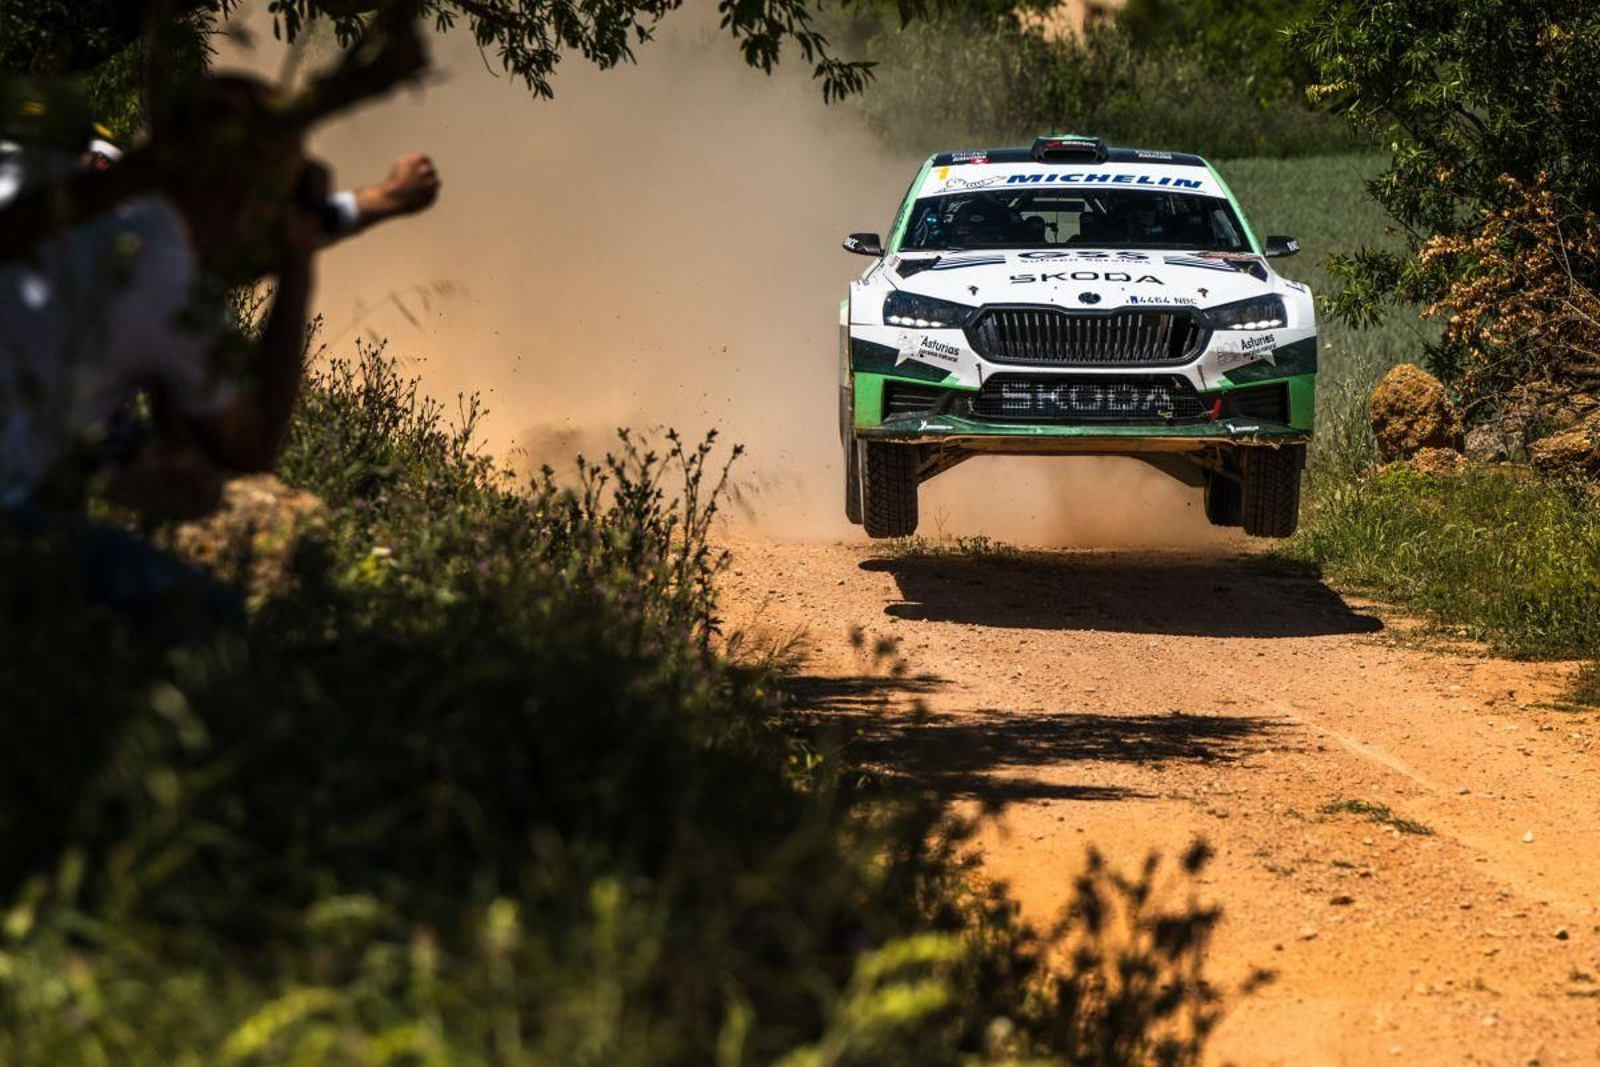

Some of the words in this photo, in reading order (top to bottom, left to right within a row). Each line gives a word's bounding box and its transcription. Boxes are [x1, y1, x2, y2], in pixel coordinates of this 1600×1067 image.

[1006, 173, 1204, 189] MICHELIN
[1009, 271, 1165, 285] SKODA
[920, 335, 960, 356] Asturias
[1241, 333, 1275, 351] Asturias
[1002, 384, 1175, 410] SKODA
